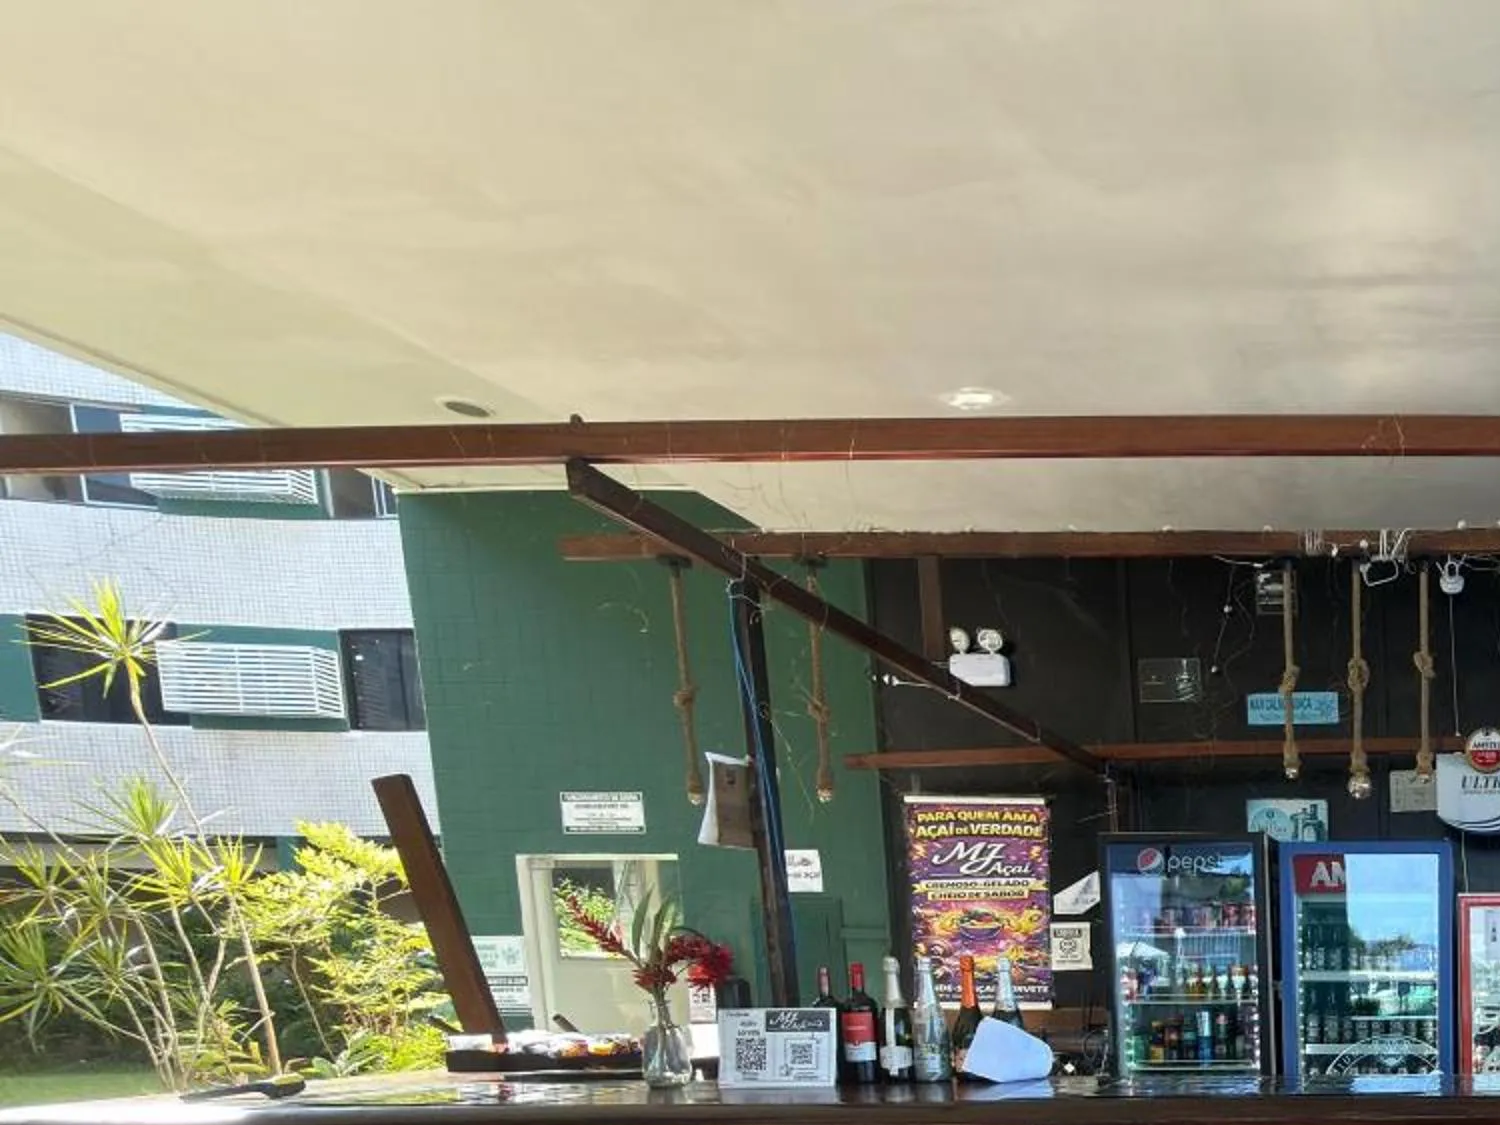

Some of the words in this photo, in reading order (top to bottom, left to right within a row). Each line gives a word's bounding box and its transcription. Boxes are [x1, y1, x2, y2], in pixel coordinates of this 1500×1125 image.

[917, 811, 954, 822] PARA
[958, 811, 999, 822] QUEM
[1001, 812, 1037, 823] AMA
[917, 823, 954, 838] AÇAÍ
[971, 823, 1042, 837] VERDADE
[931, 842, 1006, 875] MJ
